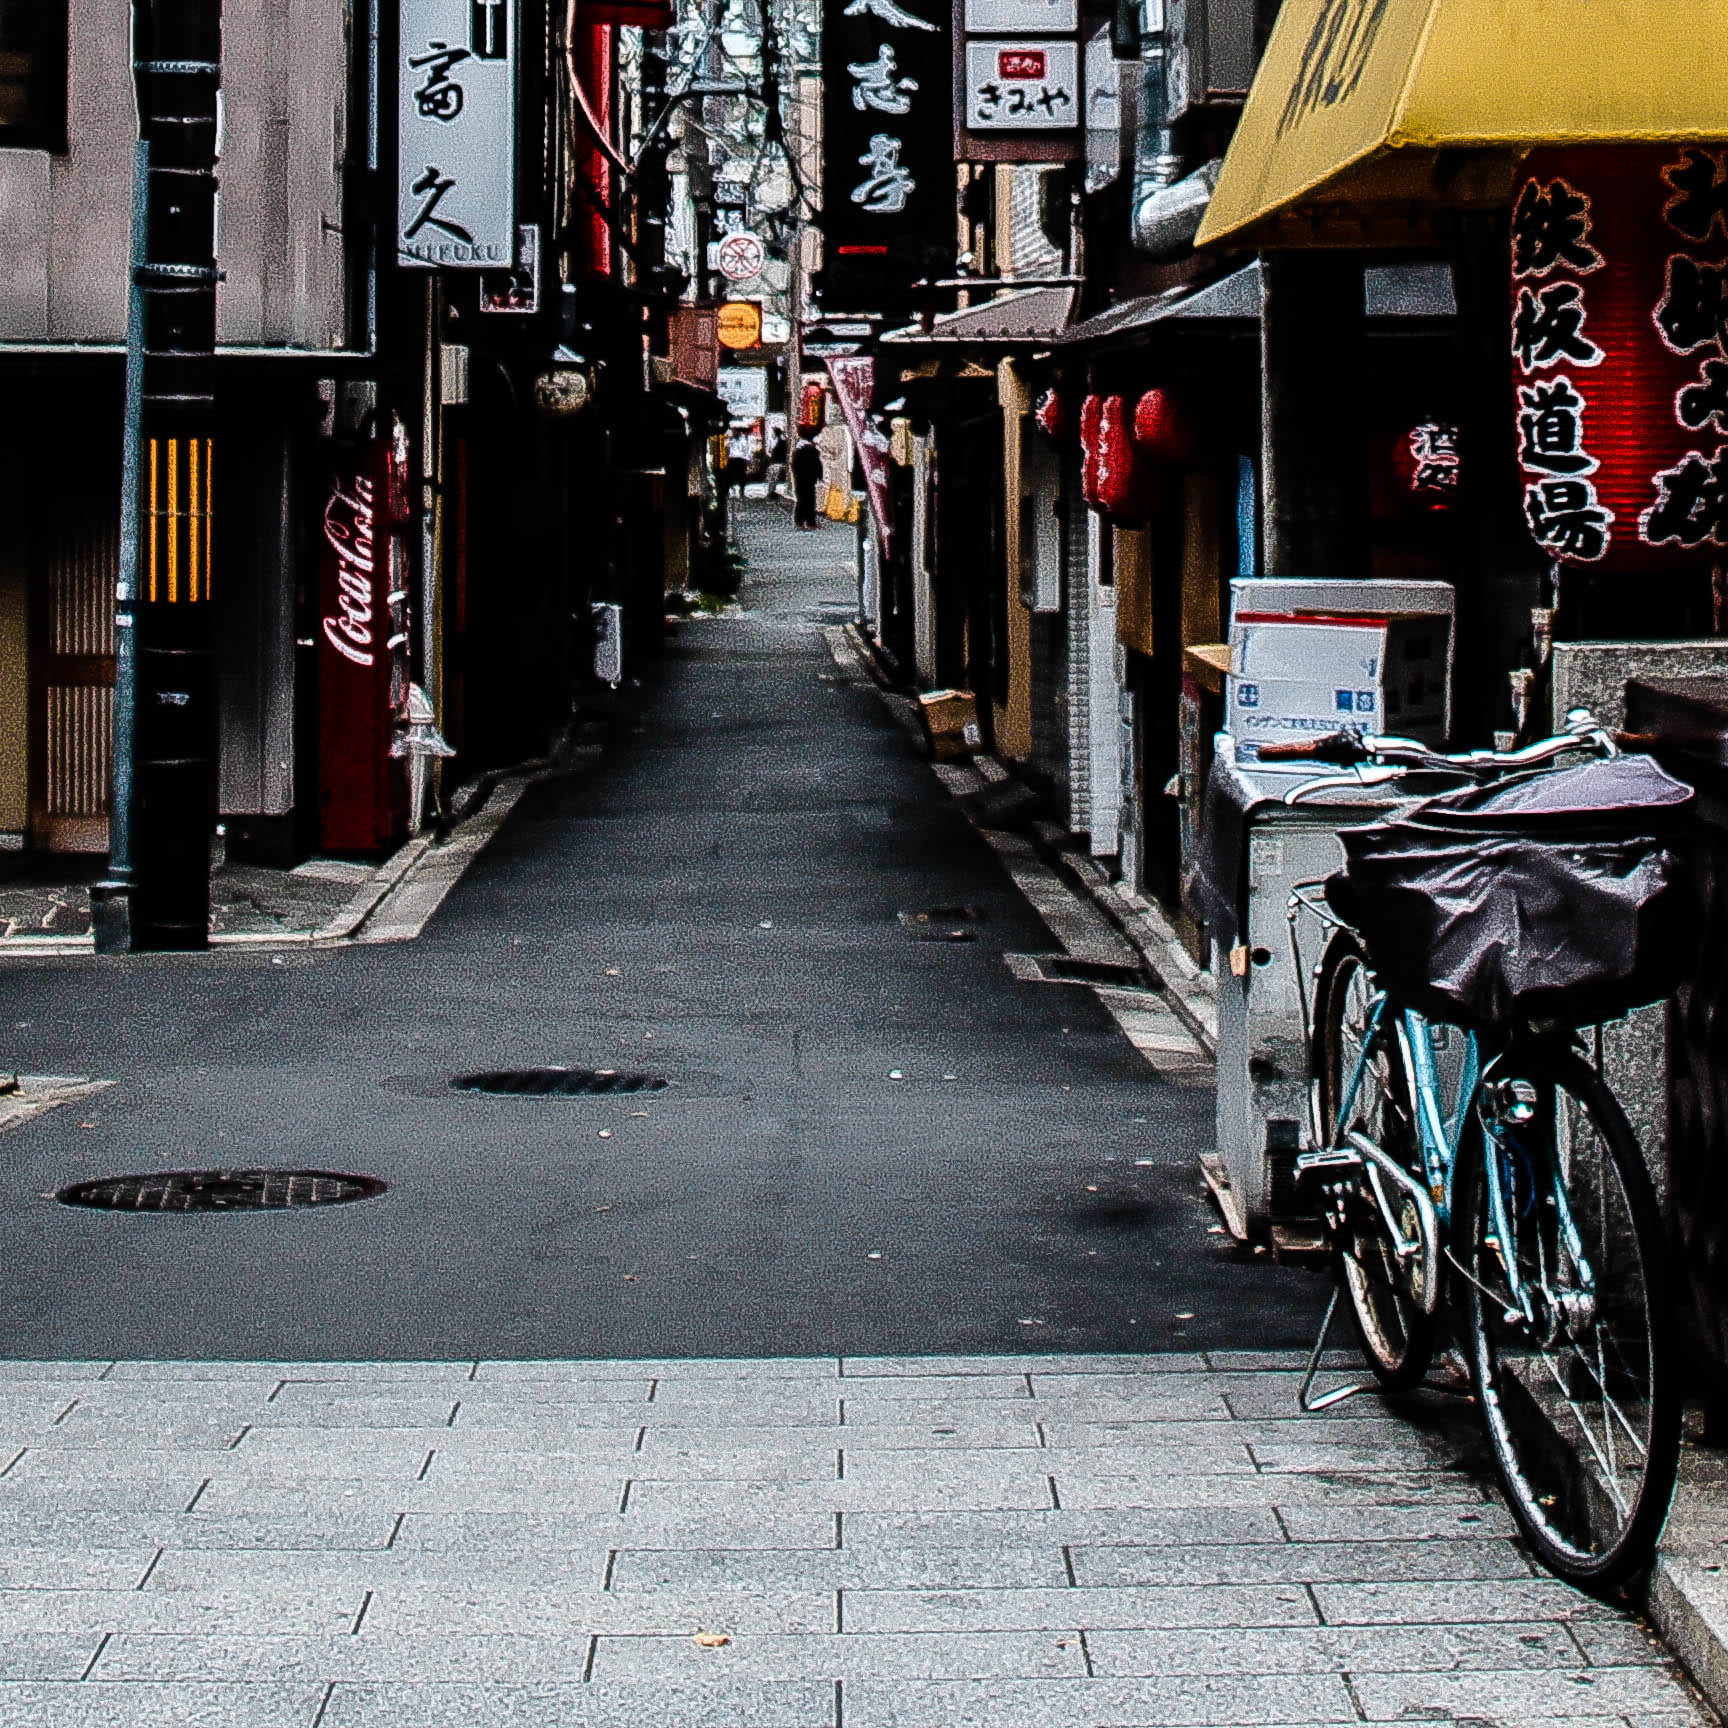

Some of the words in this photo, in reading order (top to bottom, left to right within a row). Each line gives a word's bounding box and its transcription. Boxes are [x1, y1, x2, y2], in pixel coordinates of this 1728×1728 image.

[977, 83, 1071, 120] きみや
[1511, 176, 1615, 562] 鉄板道場
